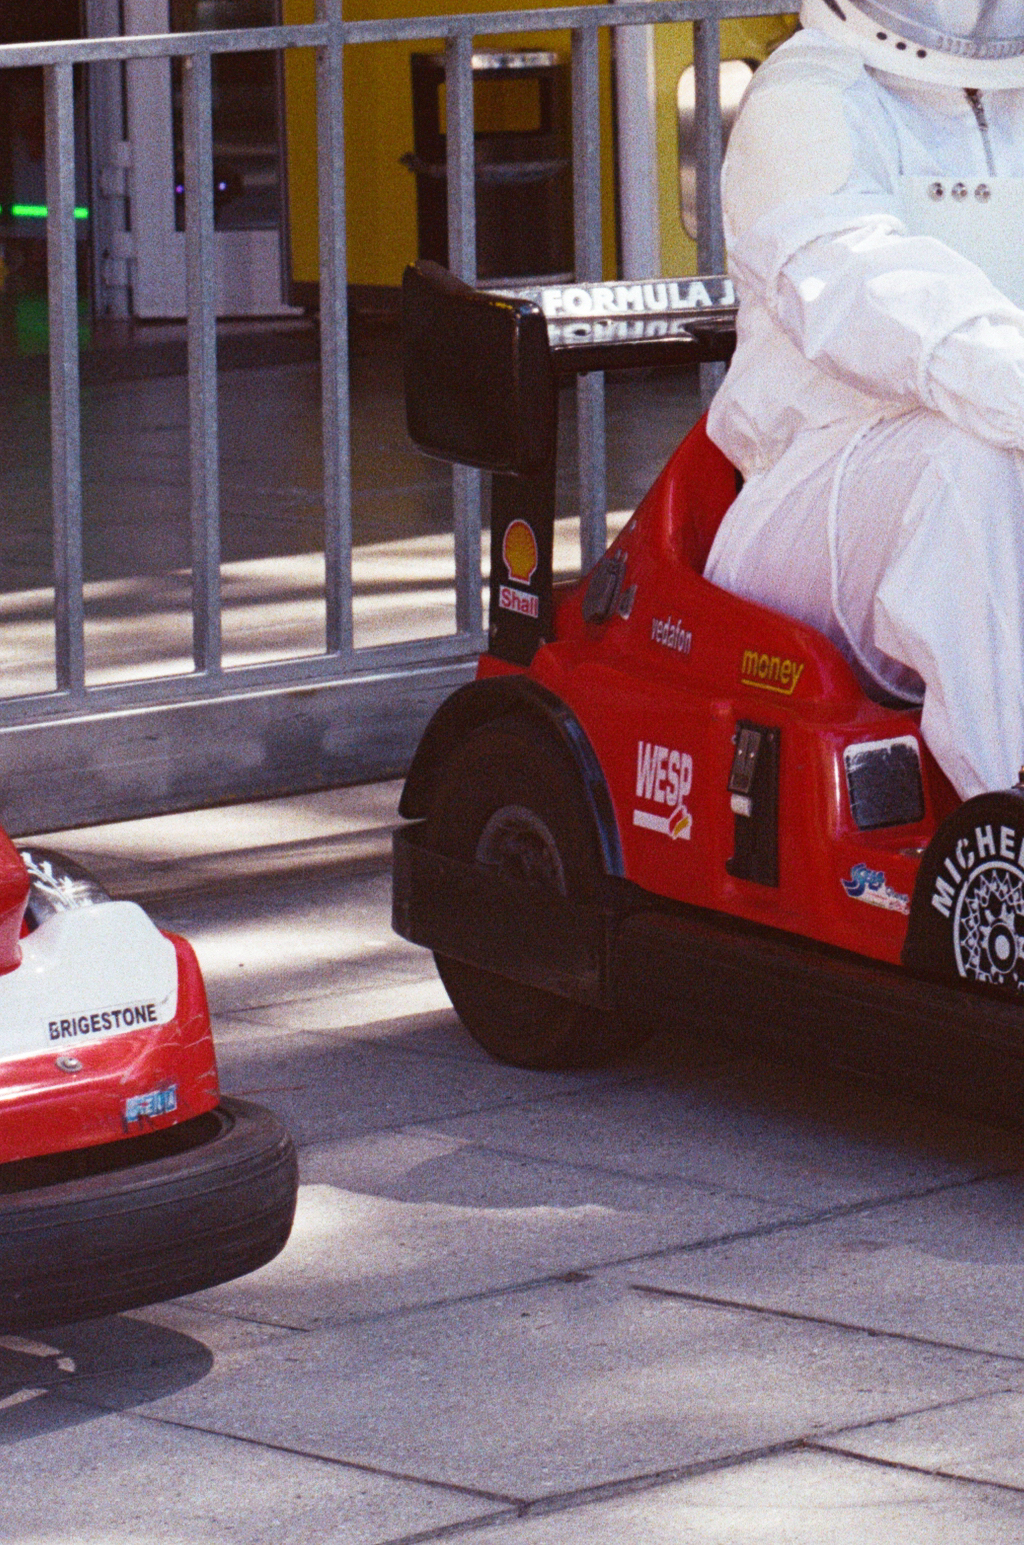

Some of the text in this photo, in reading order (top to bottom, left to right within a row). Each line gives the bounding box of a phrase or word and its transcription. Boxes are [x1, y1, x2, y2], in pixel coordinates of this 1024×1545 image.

[543, 281, 712, 315] FORMULA
[501, 588, 538, 616] Shall
[651, 615, 692, 654] vedafon
[742, 649, 804, 693] money
[636, 741, 693, 806] WESP
[48, 1004, 158, 1041] BRIGESTONE
